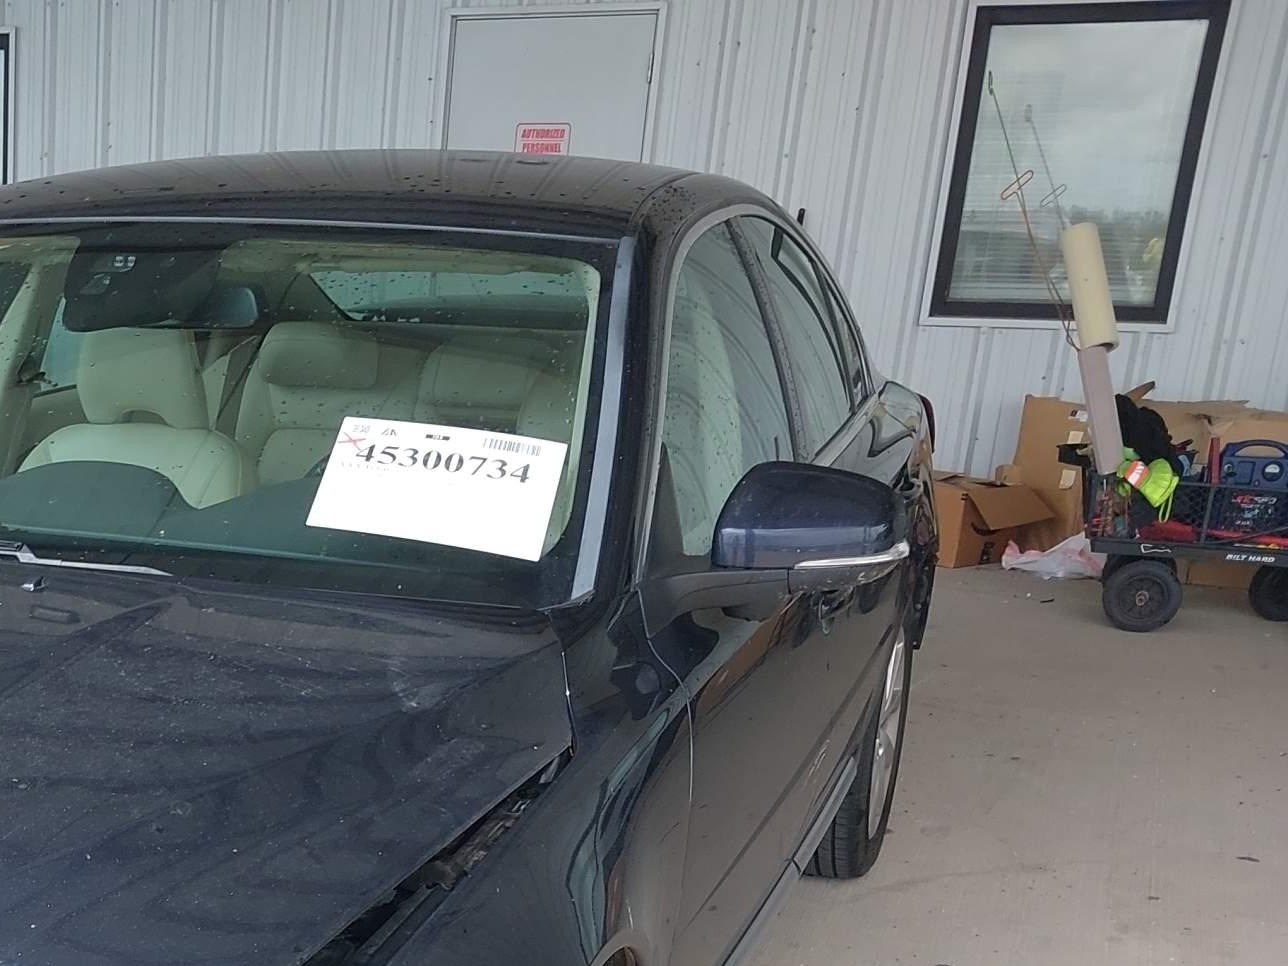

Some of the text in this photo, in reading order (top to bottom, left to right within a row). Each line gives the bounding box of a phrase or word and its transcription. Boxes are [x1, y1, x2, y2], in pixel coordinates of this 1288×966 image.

[521, 128, 566, 139] AUTHORIZED
[522, 142, 562, 153] PERSONNEL
[355, 444, 531, 484] 45300734
